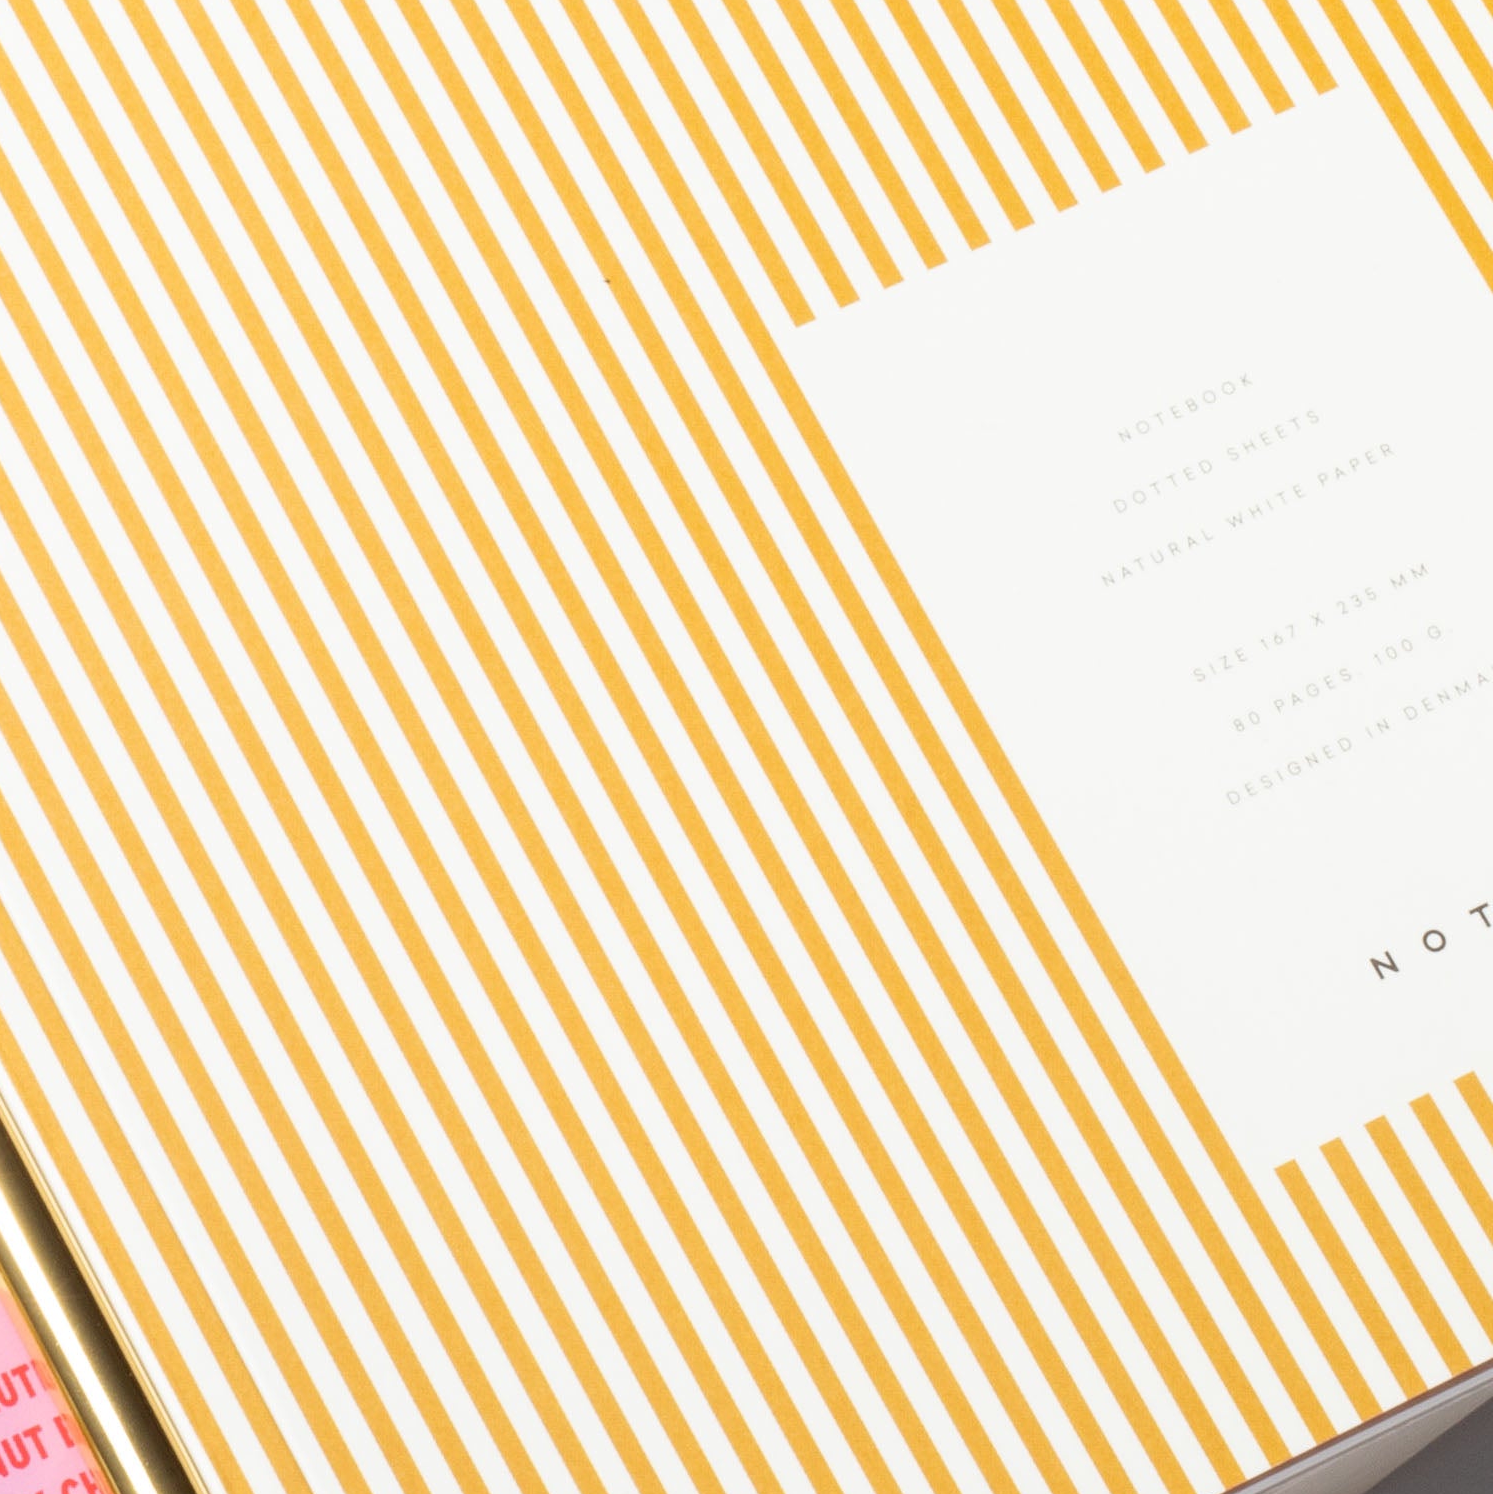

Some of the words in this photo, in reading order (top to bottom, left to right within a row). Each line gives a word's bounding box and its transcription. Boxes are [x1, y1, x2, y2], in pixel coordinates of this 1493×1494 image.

[1113, 459, 1213, 513] DOTTED
[1226, 410, 1320, 461] SHEETS
[1118, 373, 1252, 443] NOTEBOOK
[1101, 528, 1214, 587] NATURAL
[1226, 483, 1306, 528] WHITE
[1317, 443, 1394, 486] PAPER
[1193, 647, 1248, 682] SIZE
[1260, 624, 1296, 650] 167
[1336, 587, 1378, 615] 235
[1390, 564, 1428, 589] MM
[1226, 737, 1353, 805] DESIGNED
[1365, 718, 1390, 739] IN
[1403, 665, 1493, 721] DENMA
[1233, 711, 1261, 732] 80
[1373, 638, 1414, 665] 100
